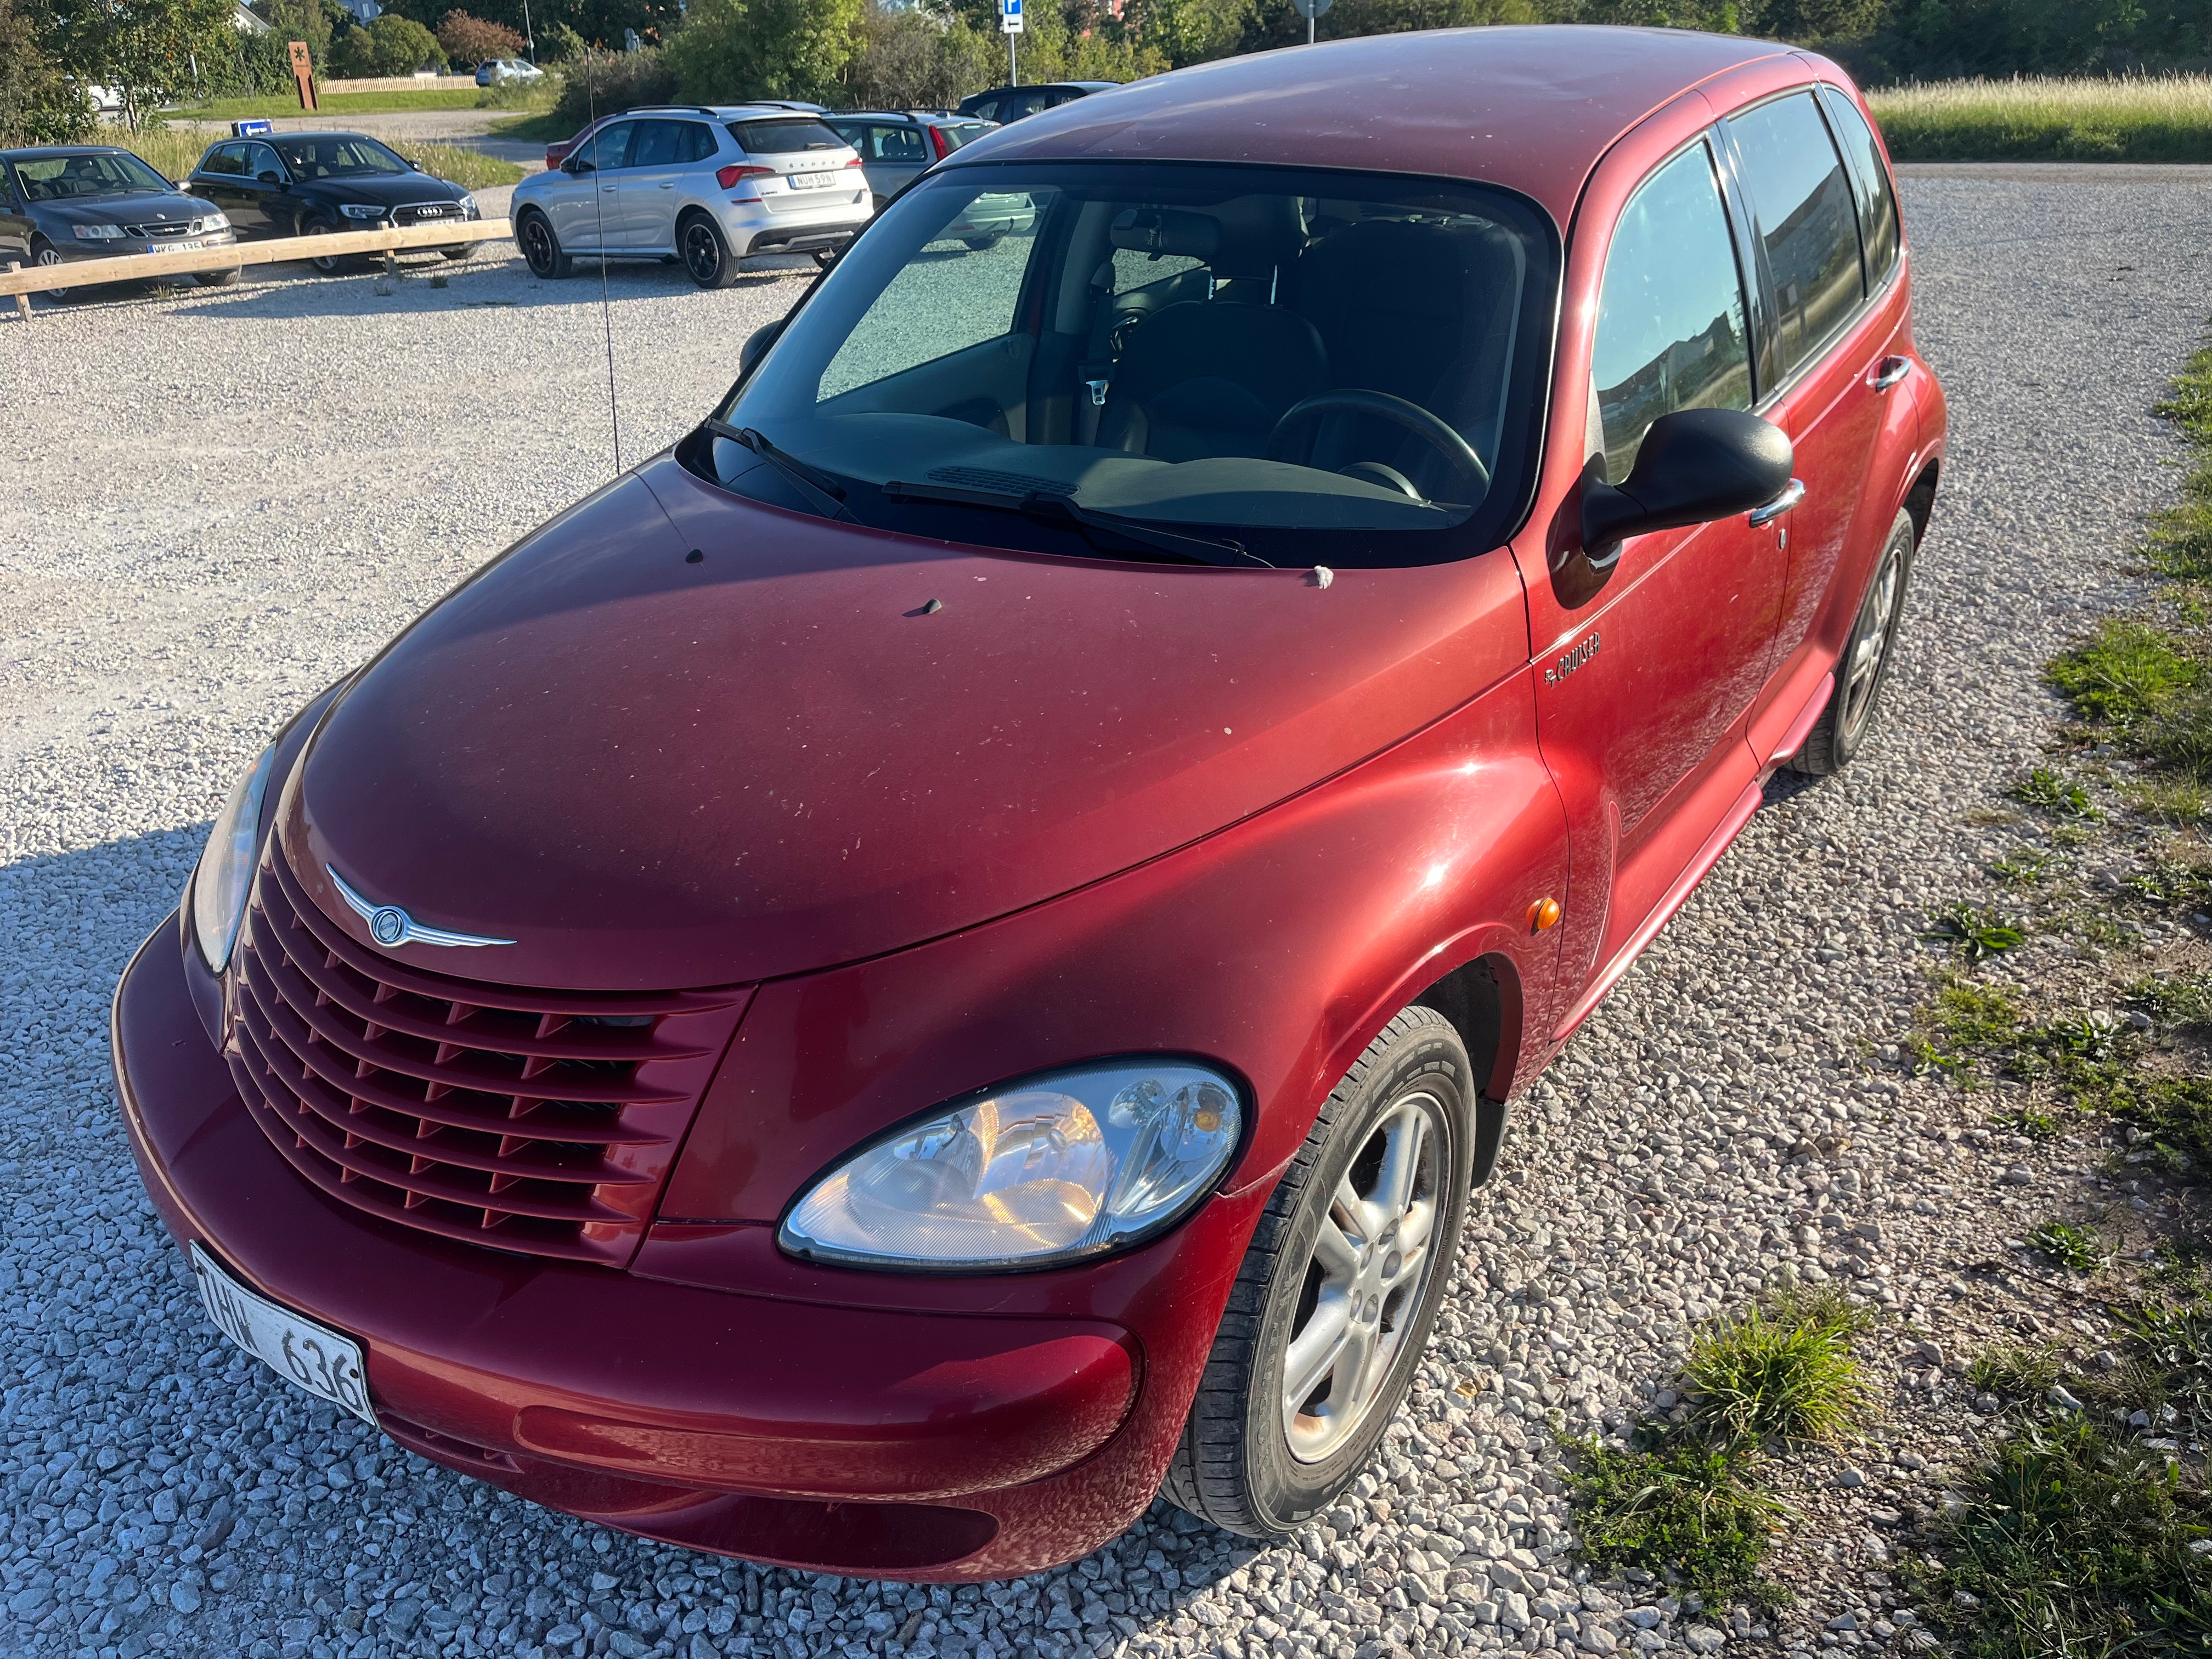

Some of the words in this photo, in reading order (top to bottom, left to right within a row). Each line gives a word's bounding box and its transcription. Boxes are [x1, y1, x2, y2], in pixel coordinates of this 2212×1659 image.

[797, 174, 814, 186] NUH
[1556, 631, 1600, 682] CRUISER
[280, 1328, 364, 1412] 636
